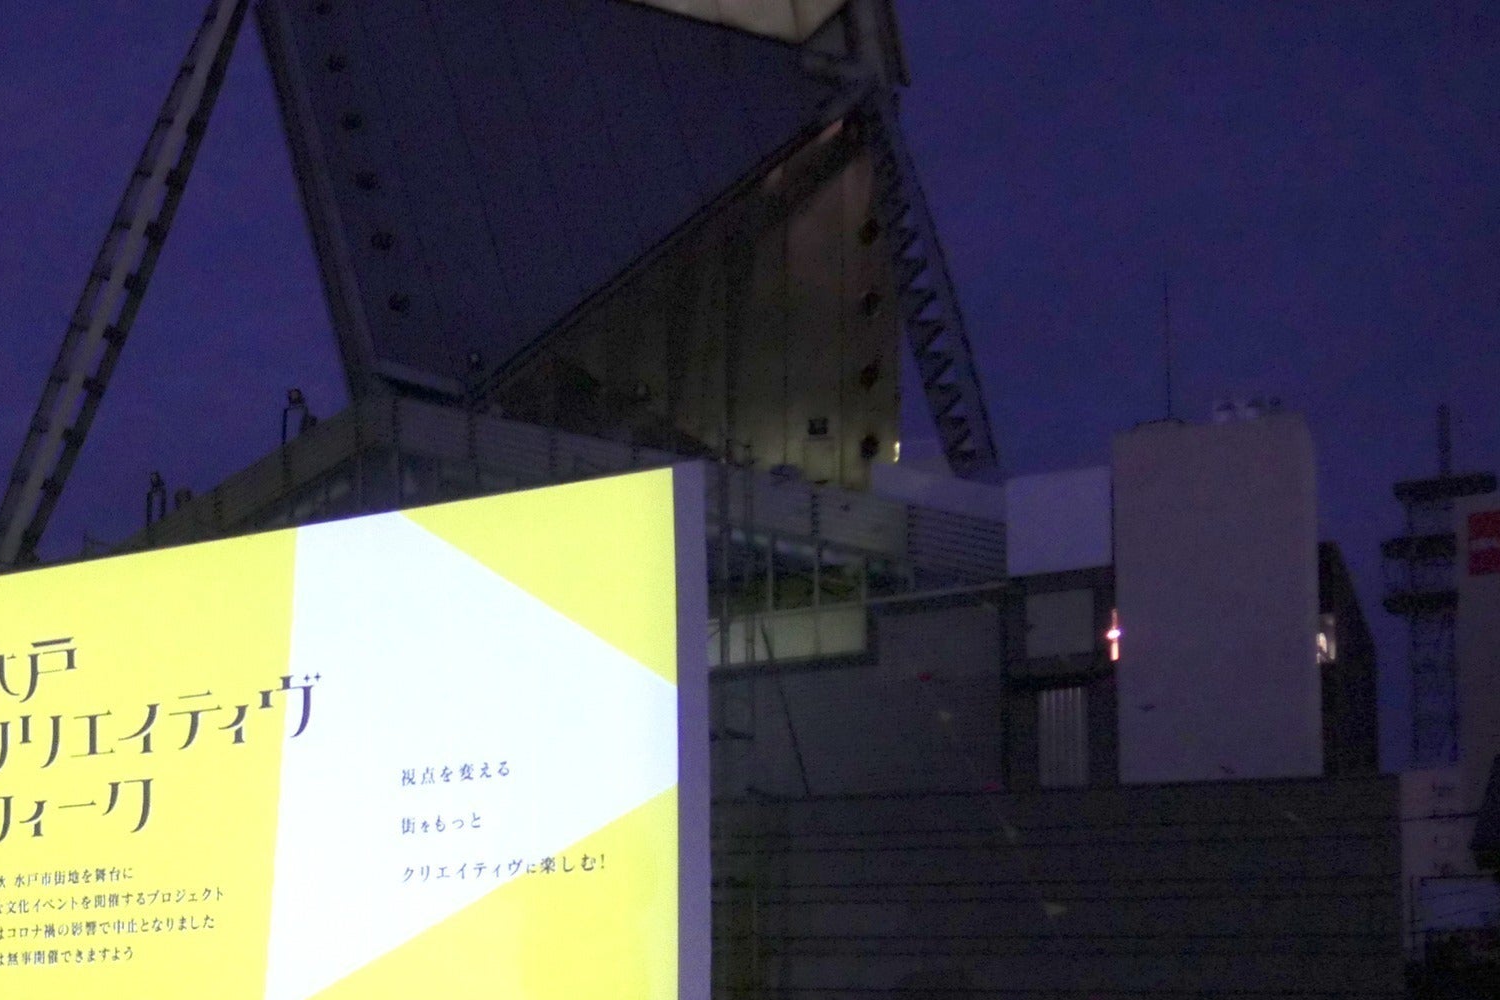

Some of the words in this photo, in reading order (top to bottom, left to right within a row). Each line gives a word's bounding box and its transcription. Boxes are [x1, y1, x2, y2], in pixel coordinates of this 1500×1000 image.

[401, 760, 510, 787] 視点を変える
[401, 811, 482, 835] 街をもっと
